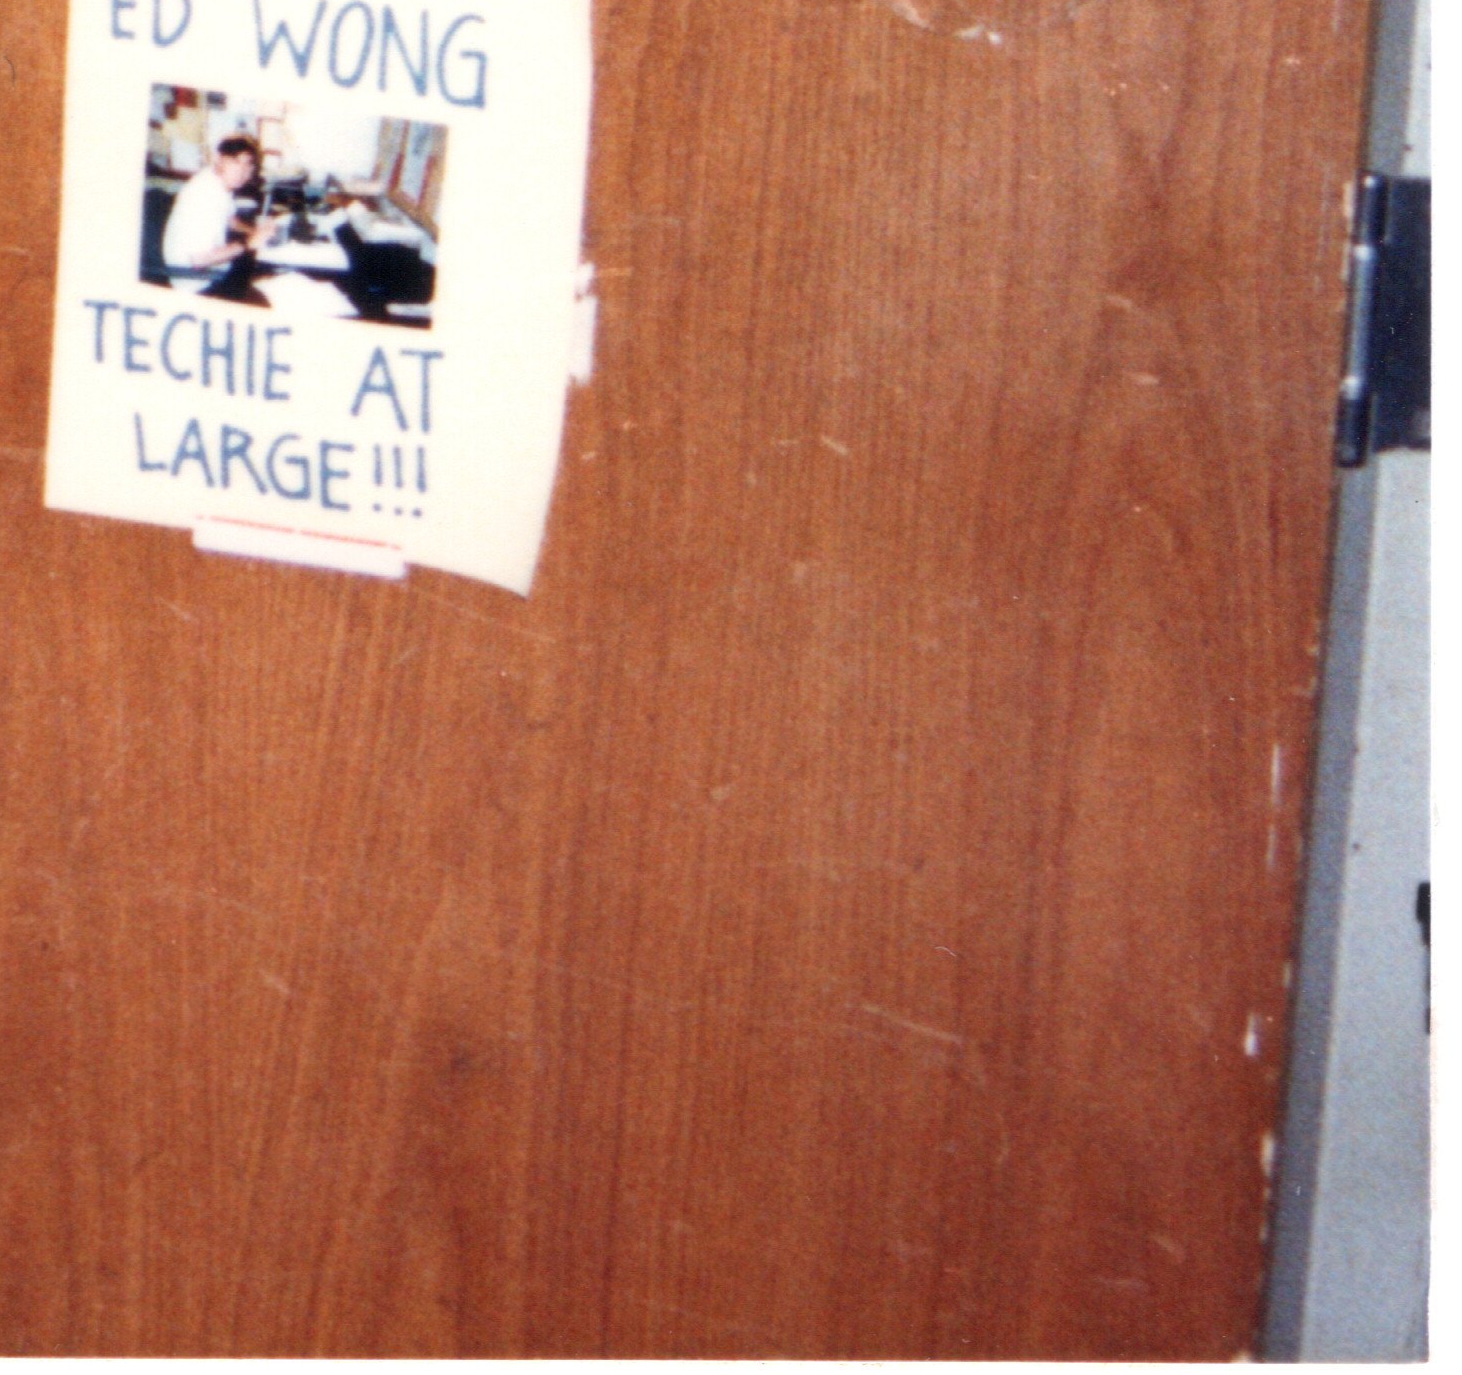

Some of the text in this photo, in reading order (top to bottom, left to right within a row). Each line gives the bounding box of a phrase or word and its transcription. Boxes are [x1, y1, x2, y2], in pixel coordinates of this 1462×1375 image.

[82, 298, 445, 435] TECHIE AT
[133, 411, 430, 519] LARGE!!!
